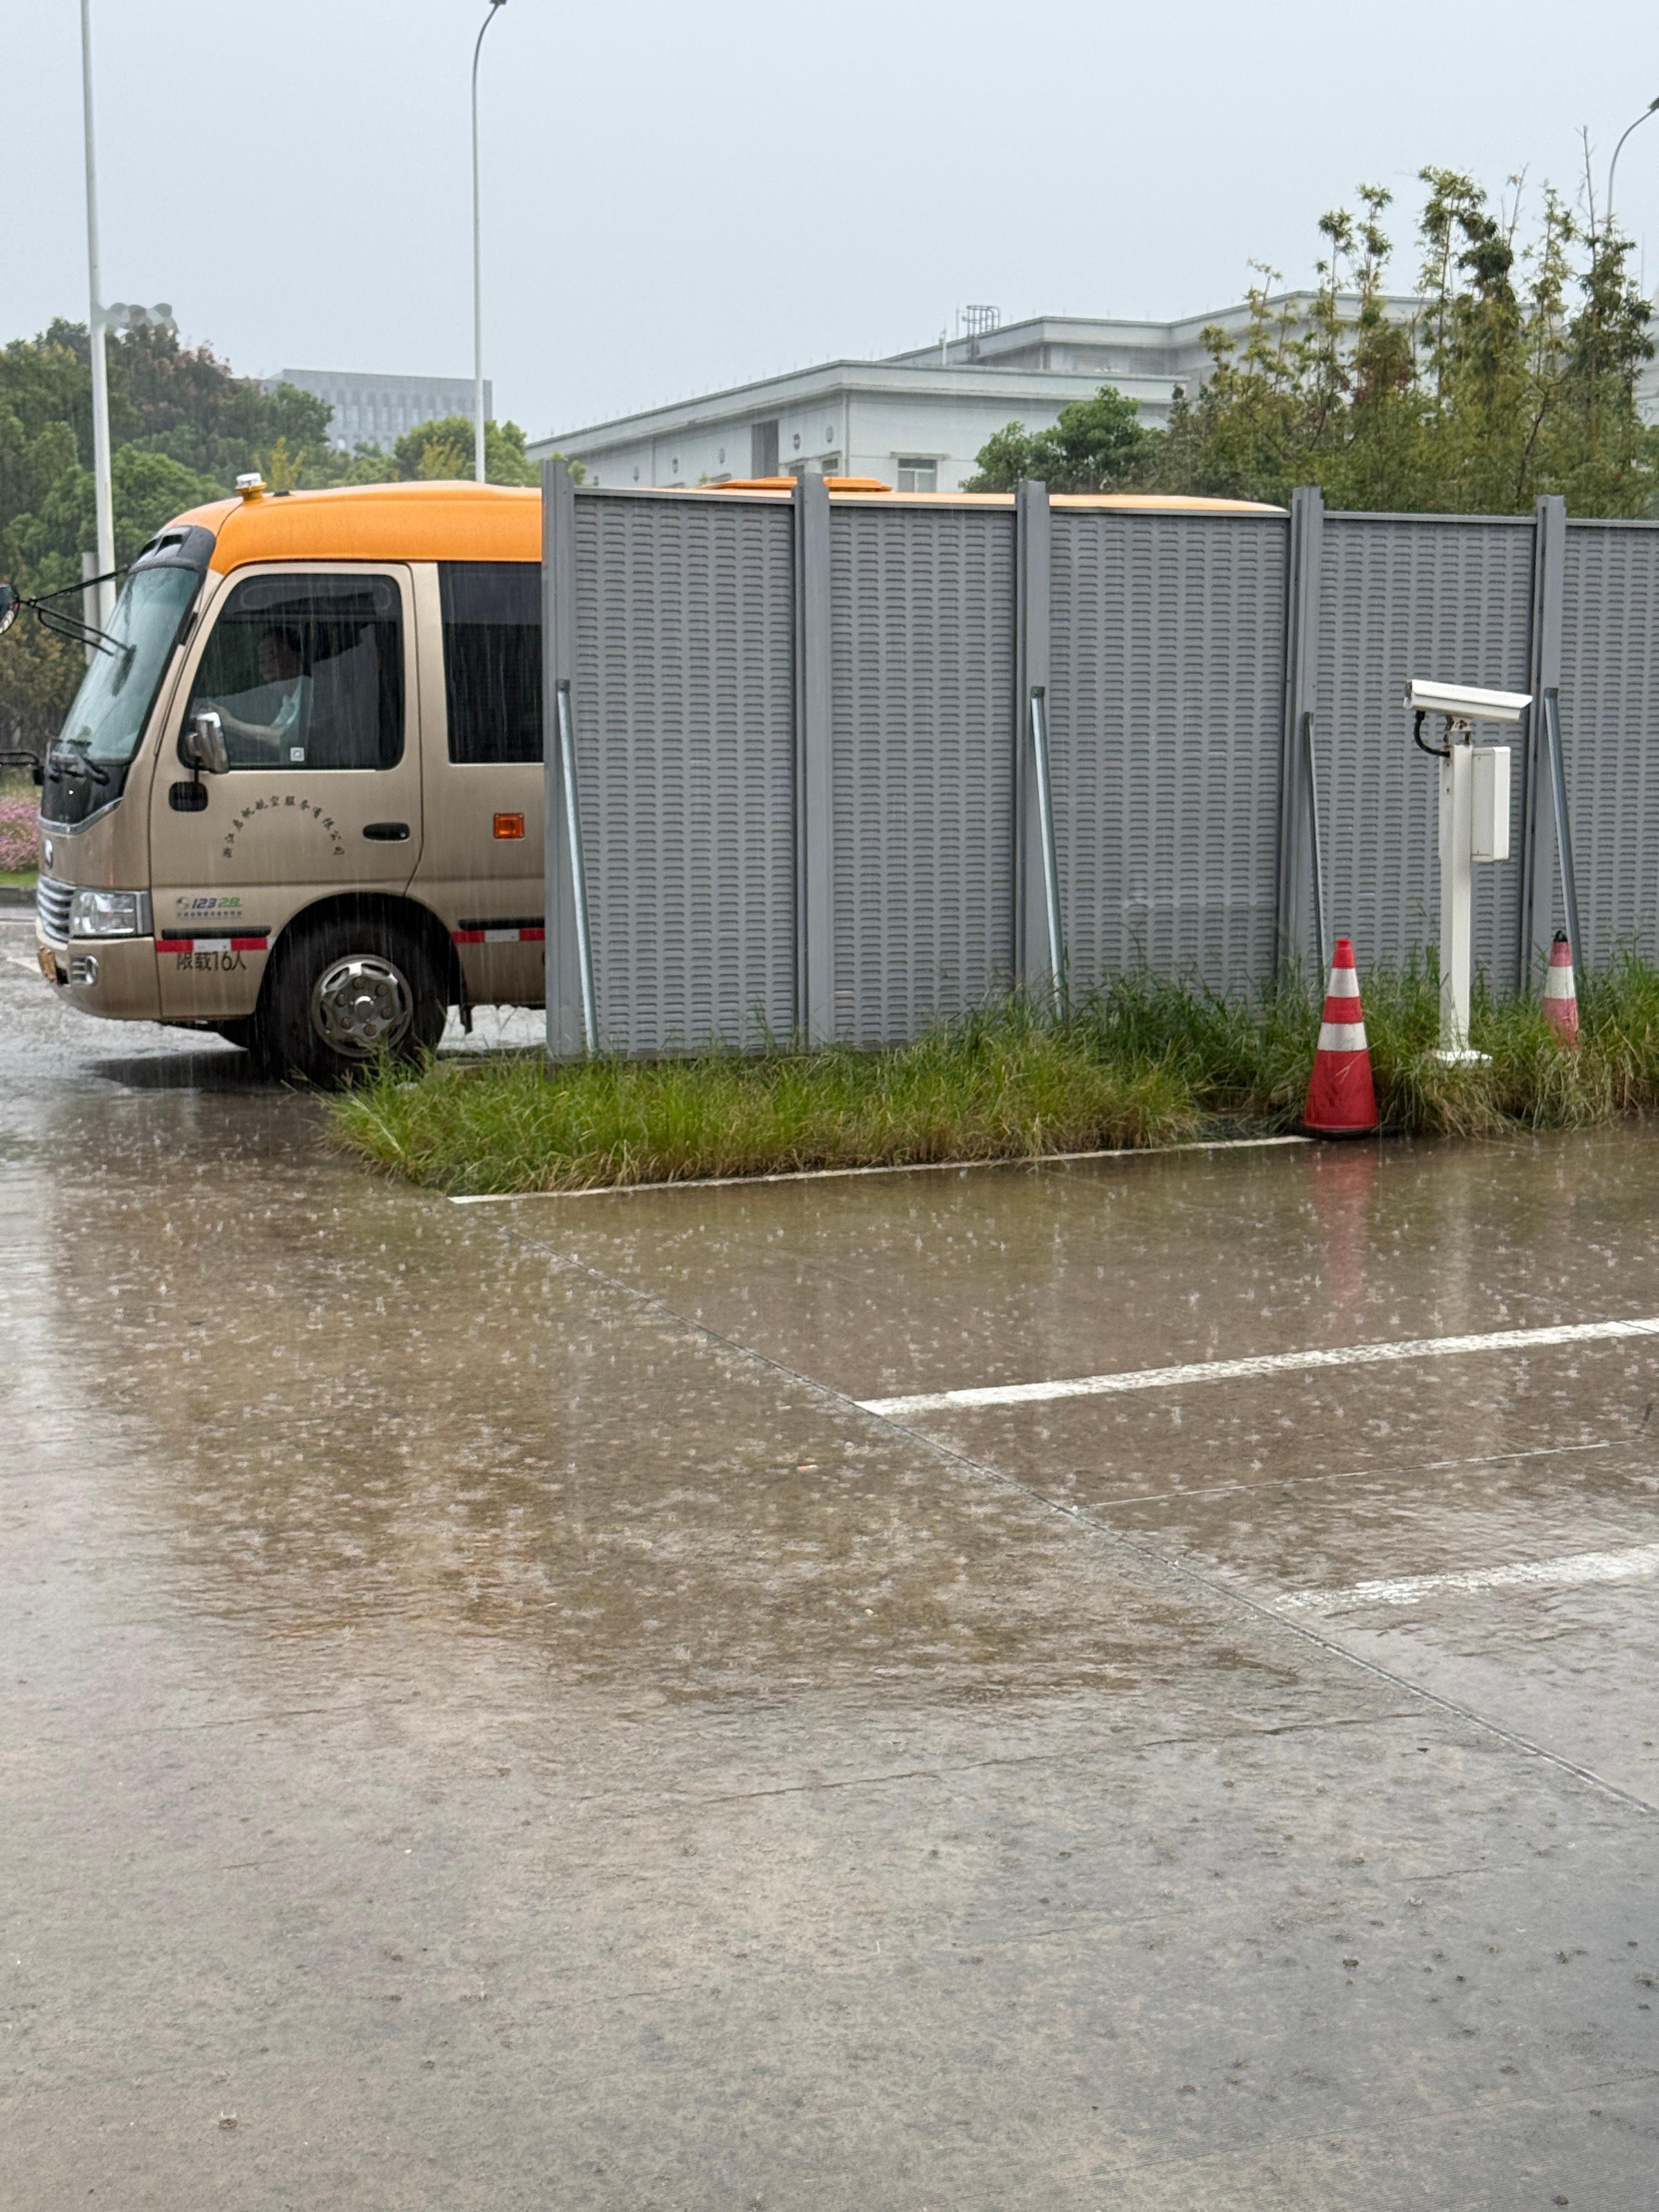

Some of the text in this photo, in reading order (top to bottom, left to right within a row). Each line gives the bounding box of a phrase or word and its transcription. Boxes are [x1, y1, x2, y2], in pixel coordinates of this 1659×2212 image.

[191, 897, 242, 909] 12328
[177, 951, 246, 971] 限载16人
